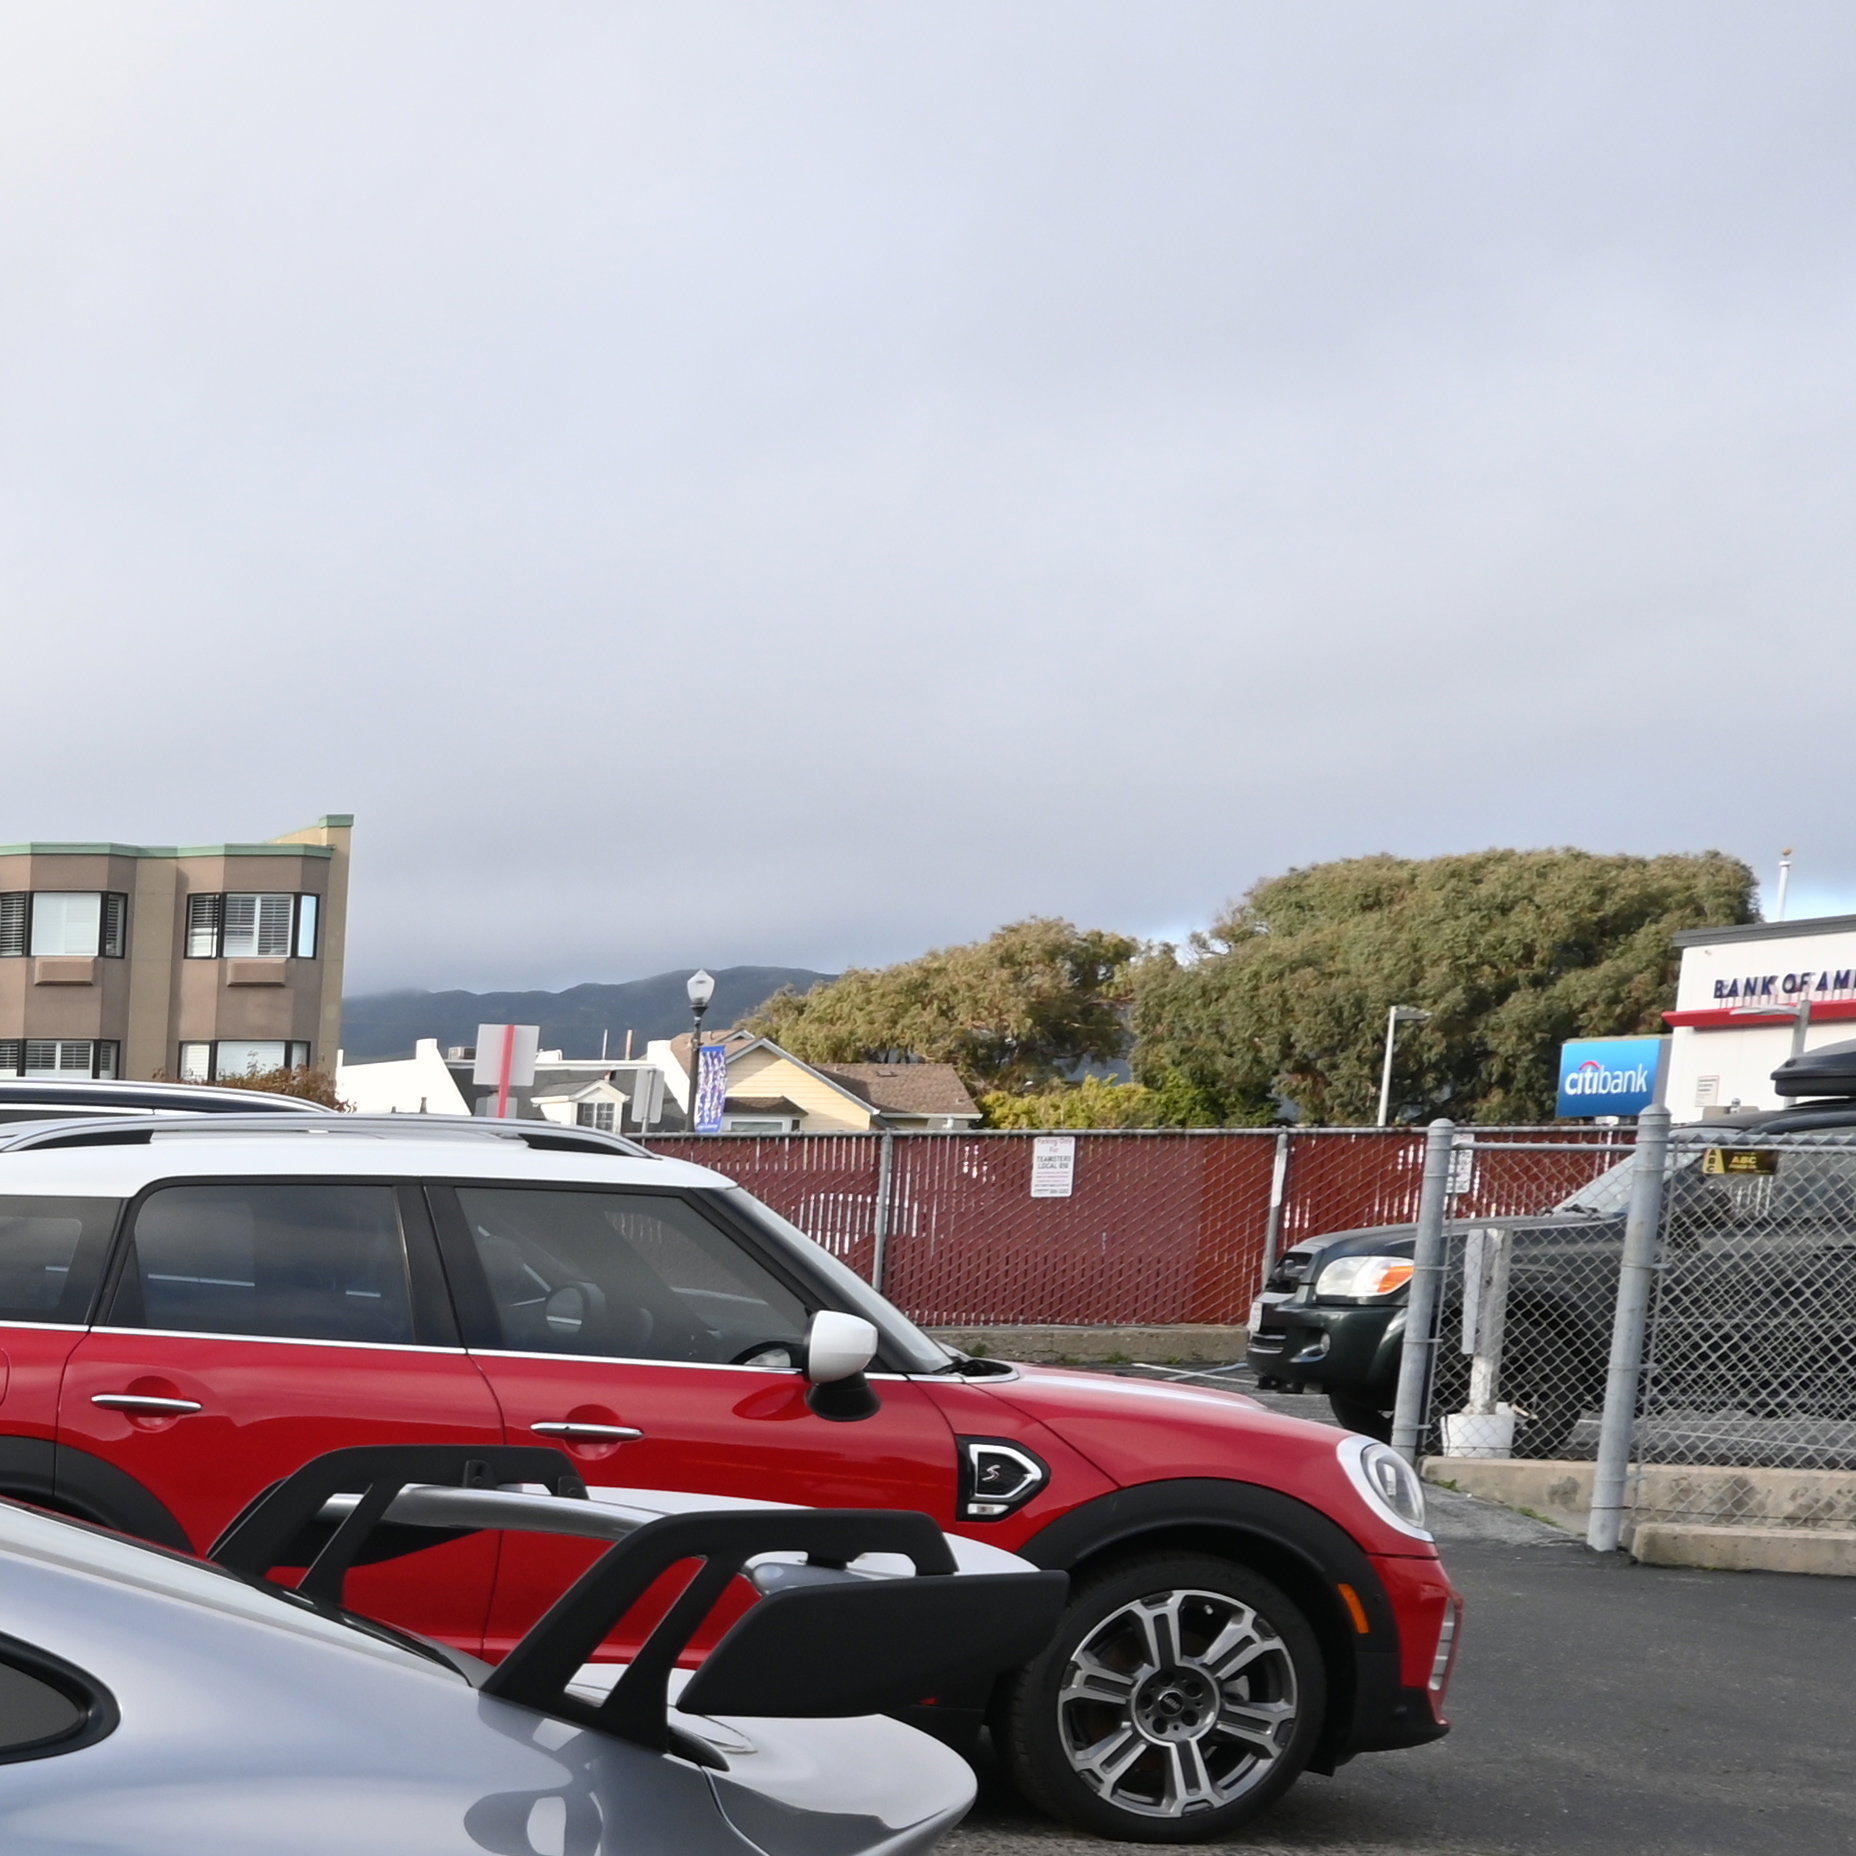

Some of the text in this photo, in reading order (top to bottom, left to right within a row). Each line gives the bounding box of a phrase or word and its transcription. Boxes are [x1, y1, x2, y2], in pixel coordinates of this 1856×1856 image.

[1713, 968, 1856, 999] BANK OF AM
[1564, 1060, 1648, 1096] citibank
